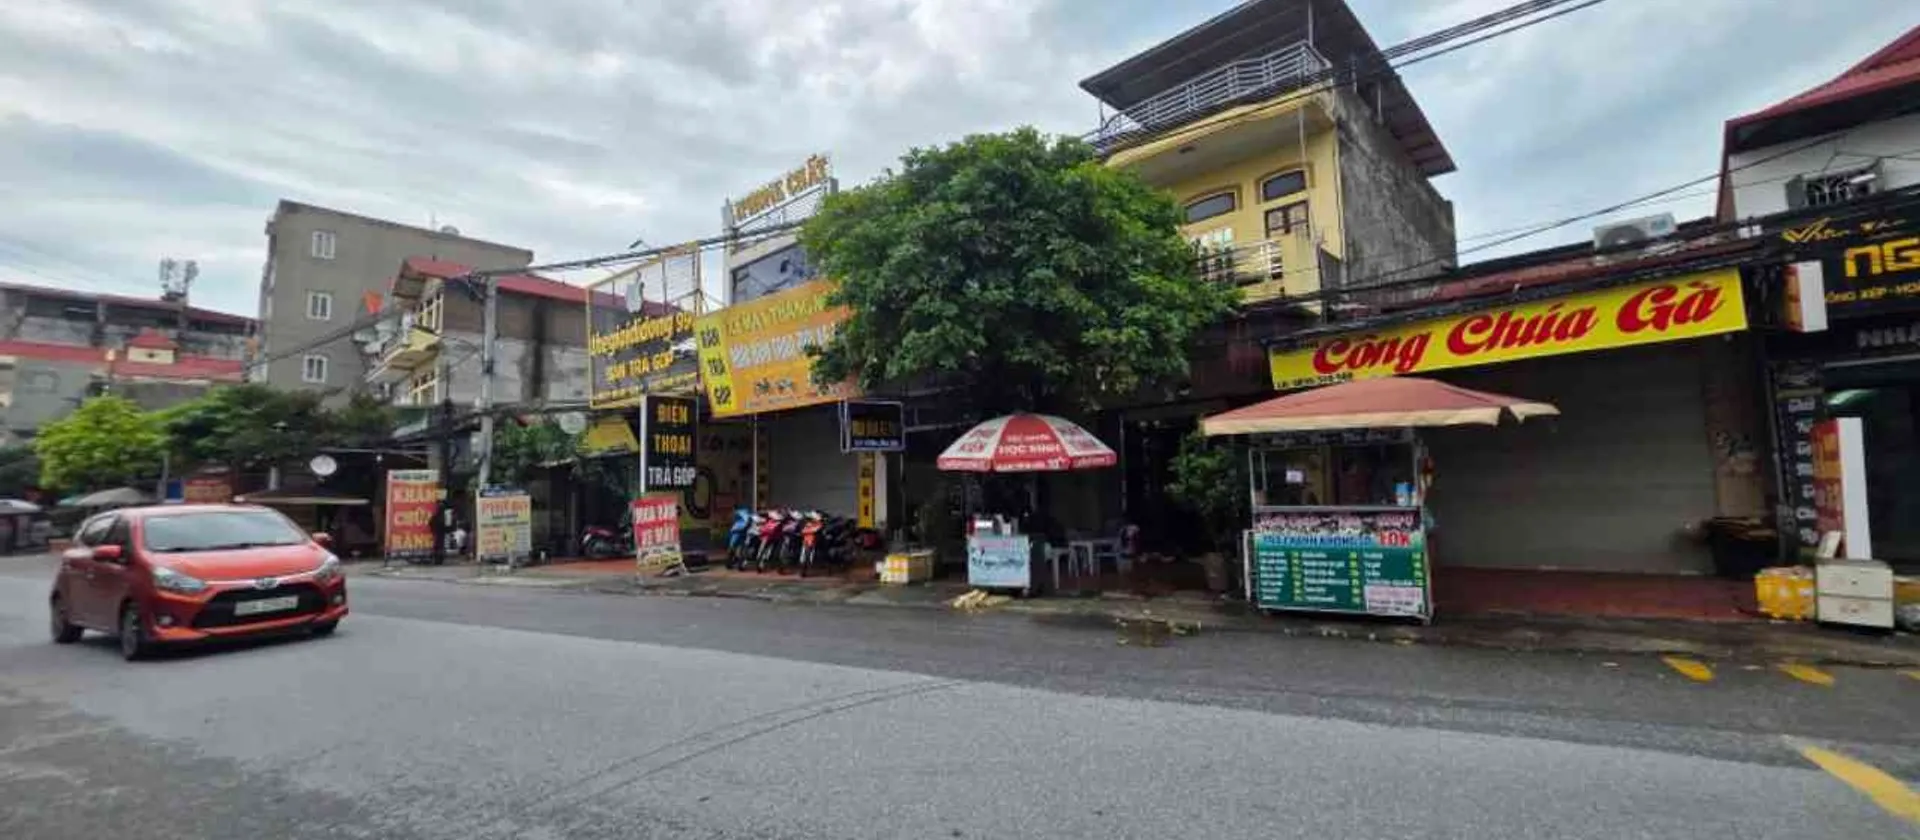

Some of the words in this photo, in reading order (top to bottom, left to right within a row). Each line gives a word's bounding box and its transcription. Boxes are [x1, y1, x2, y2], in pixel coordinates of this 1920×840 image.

[1312, 333, 1432, 374] Công
[1447, 302, 1599, 356] Chúa
[1616, 281, 1724, 333] Gà
[648, 459, 672, 486] TRẢ
[674, 461, 696, 486] GÓP
